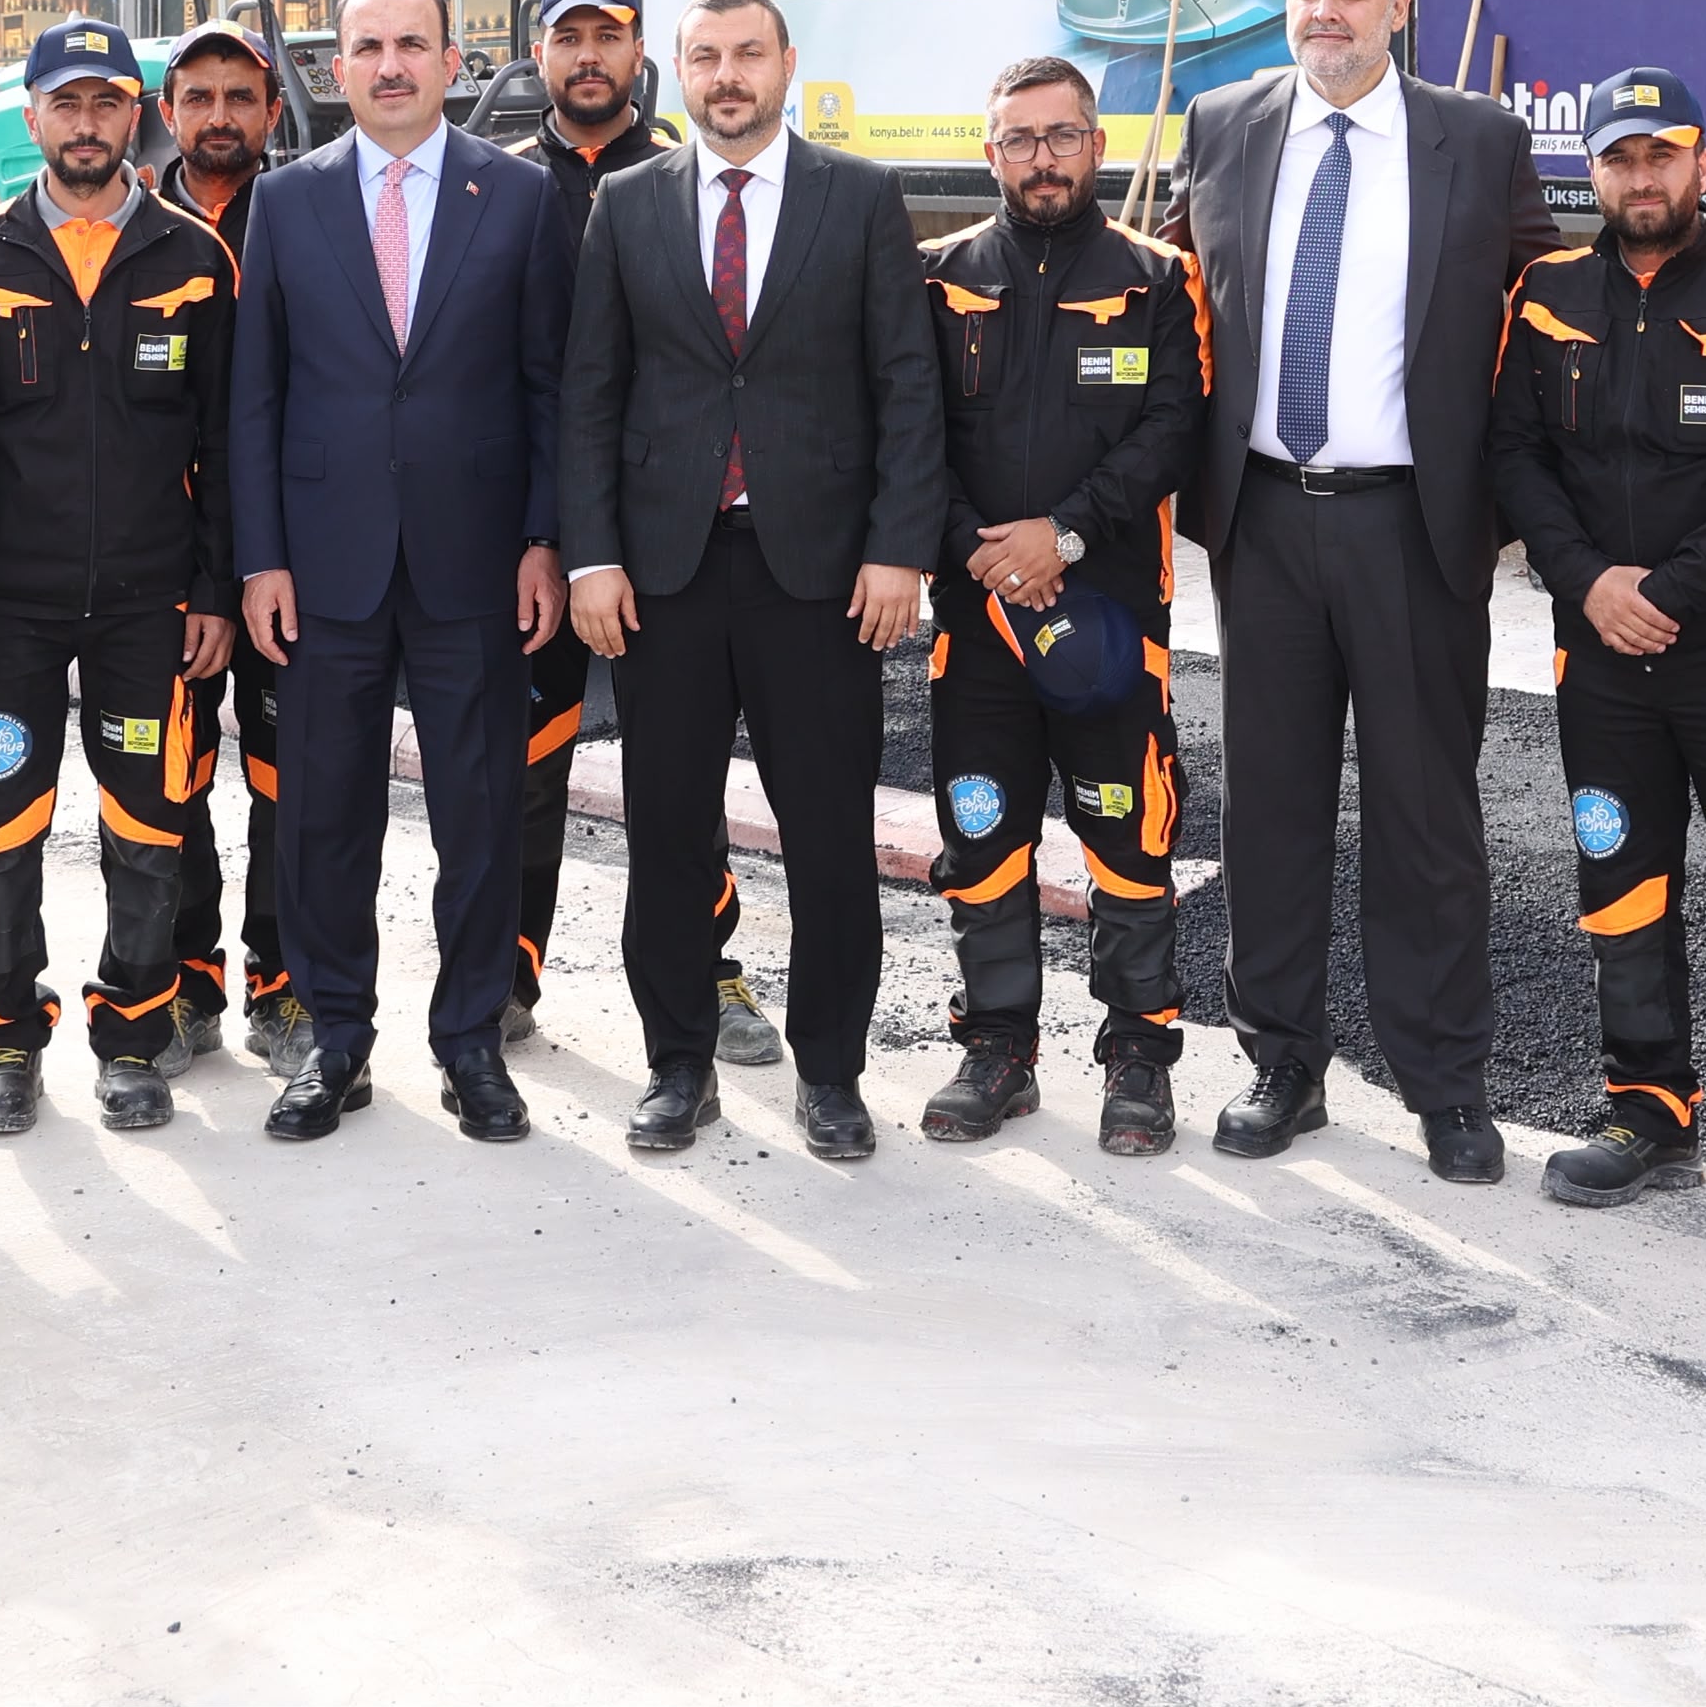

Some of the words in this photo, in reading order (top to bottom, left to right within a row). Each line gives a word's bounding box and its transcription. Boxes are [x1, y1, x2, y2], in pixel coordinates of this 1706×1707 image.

[869, 126, 924, 140] konya.bel.tr
[931, 126, 952, 138] 444
[953, 126, 967, 138] 55
[968, 126, 983, 138] 42
[1545, 186, 1598, 208] ÜKŞEH
